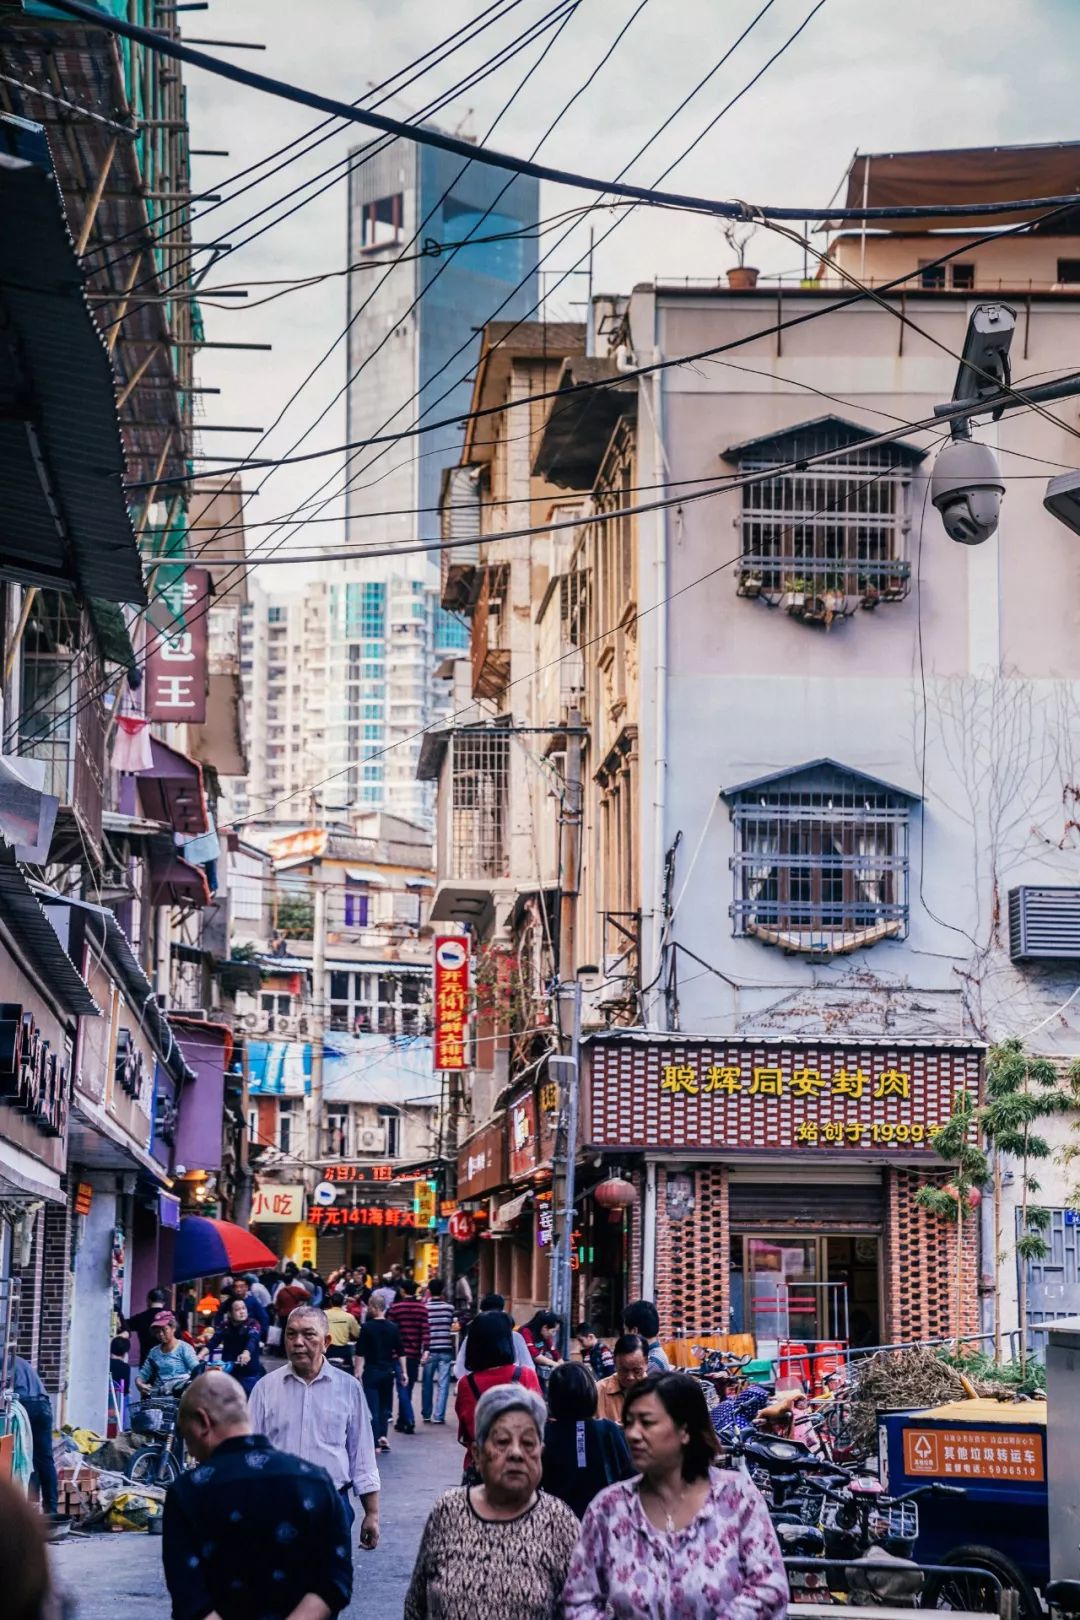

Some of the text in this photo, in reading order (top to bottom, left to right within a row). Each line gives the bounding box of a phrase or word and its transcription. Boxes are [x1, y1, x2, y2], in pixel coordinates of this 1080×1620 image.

[660, 1064, 911, 1099] 聪辉同安封肉
[253, 1193, 294, 1217] 小吃
[944, 1446, 1036, 1464] 其他垃圾转运车
